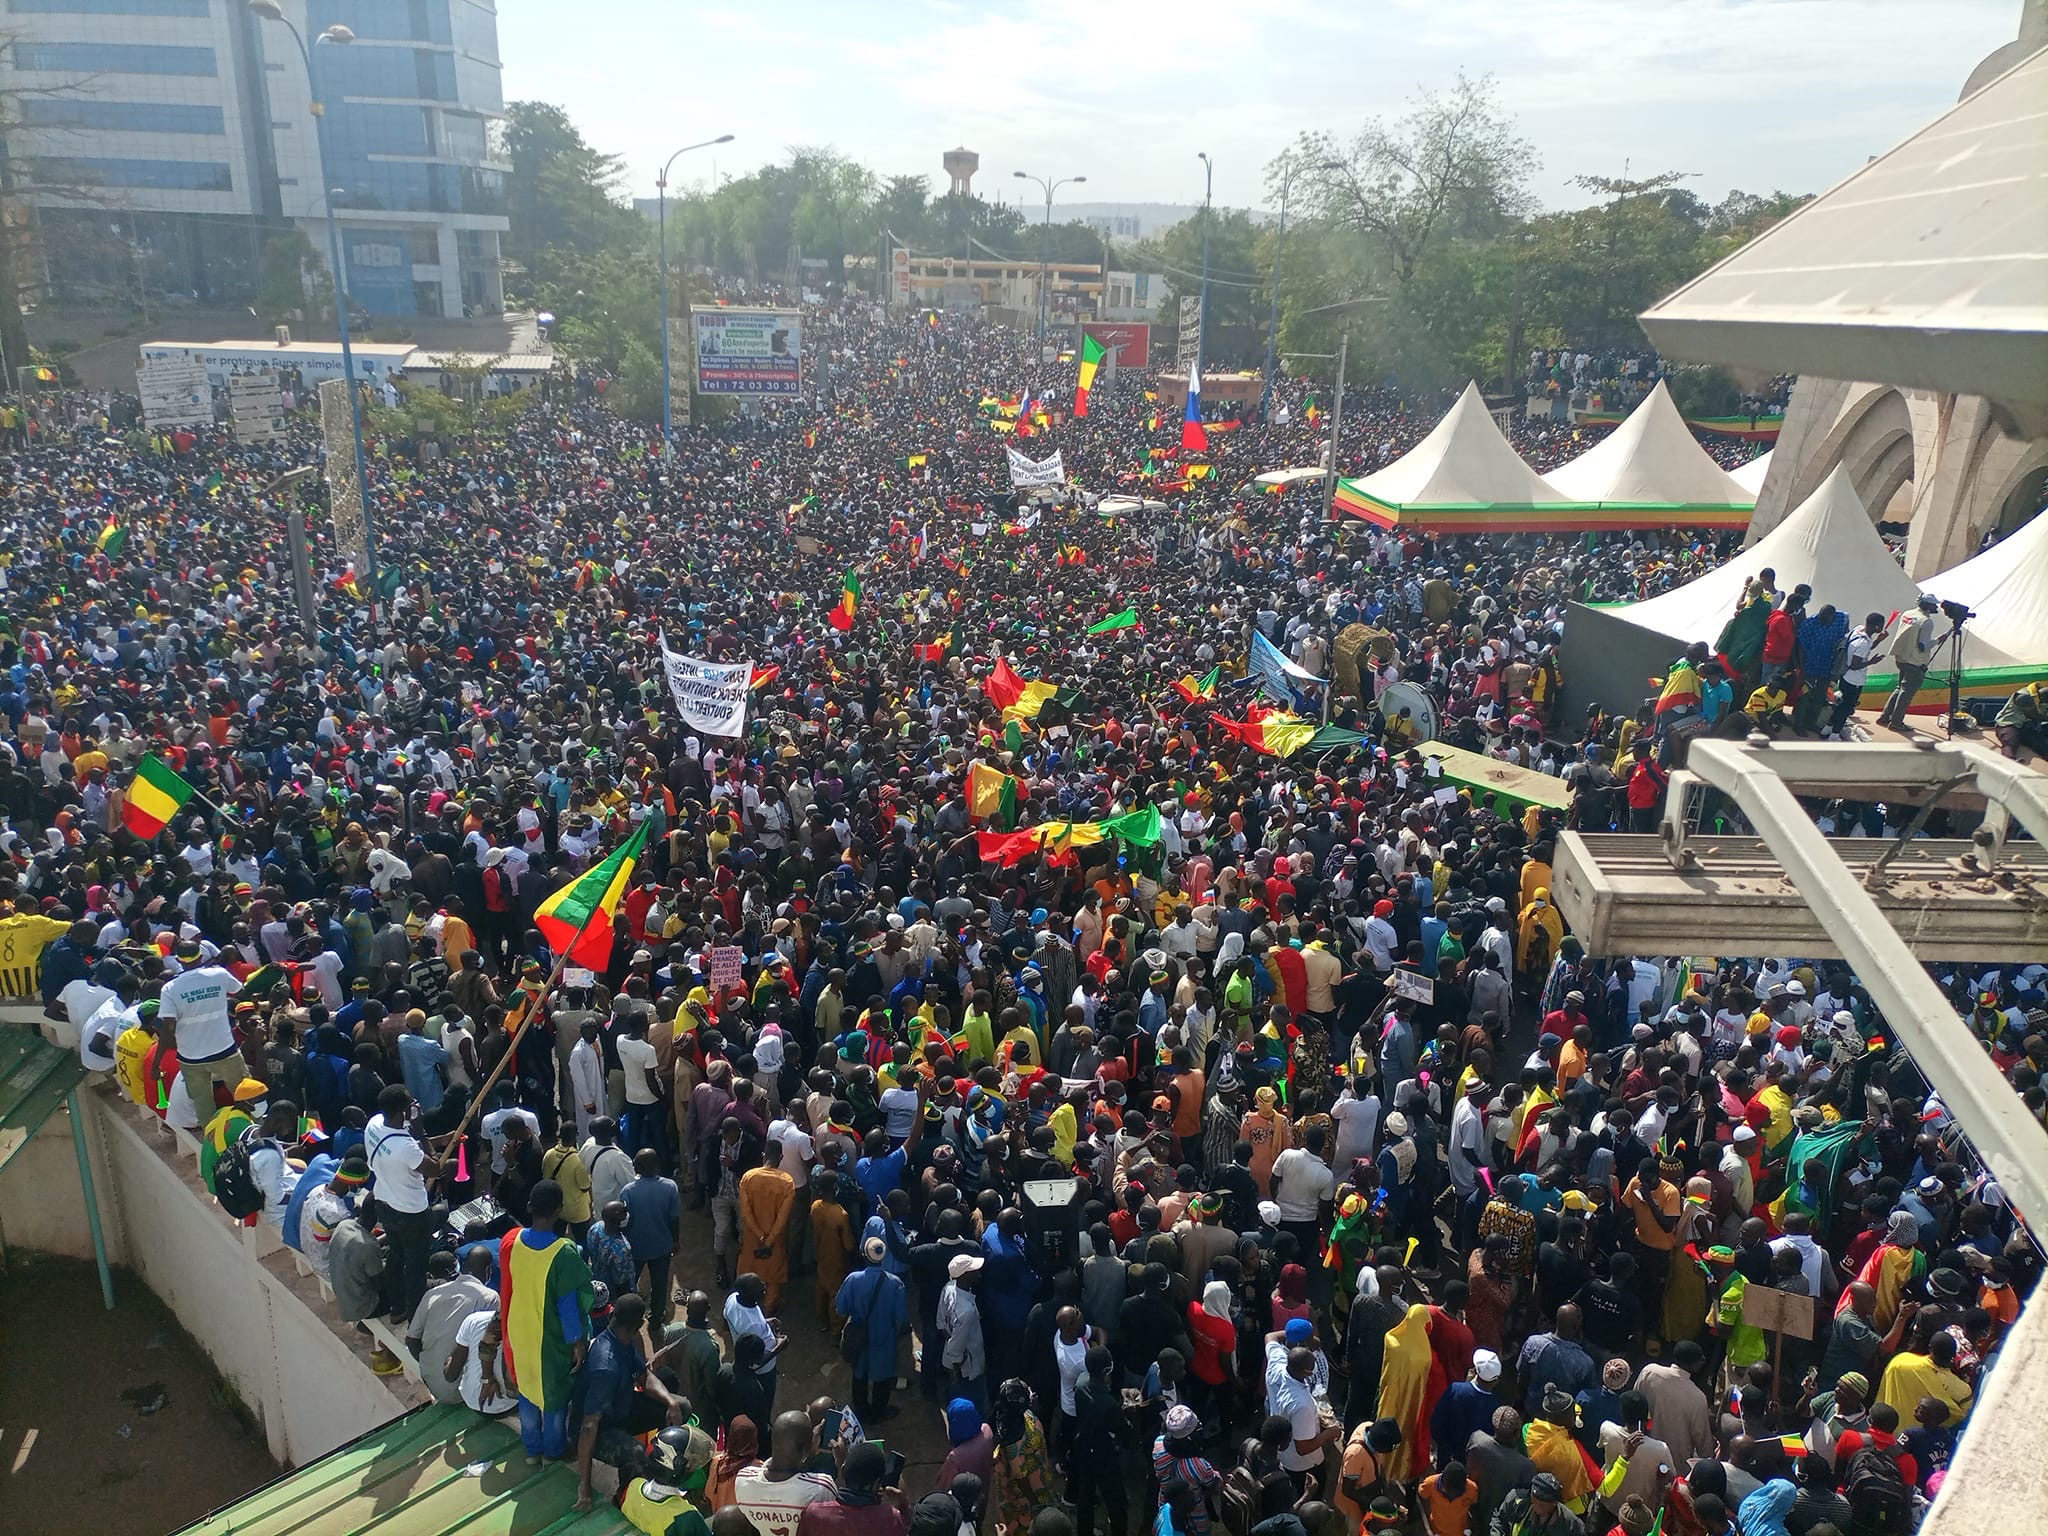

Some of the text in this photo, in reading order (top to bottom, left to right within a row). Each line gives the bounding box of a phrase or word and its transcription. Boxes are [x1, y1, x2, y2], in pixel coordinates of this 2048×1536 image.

[722, 338, 731, 347] 60
[702, 380, 720, 389] Tel
[732, 381, 745, 390] 72
[749, 381, 762, 390] 03
[767, 382, 780, 390] 30
[784, 382, 797, 391] 30
[4, 933, 14, 961] 8
[721, 961, 742, 969] ALLEZ
[724, 975, 740, 983] CHEZ
[1843, 1254, 1854, 1267] 19
[1897, 1432, 1909, 1445] 12
[749, 1510, 800, 1524] RONALDO
